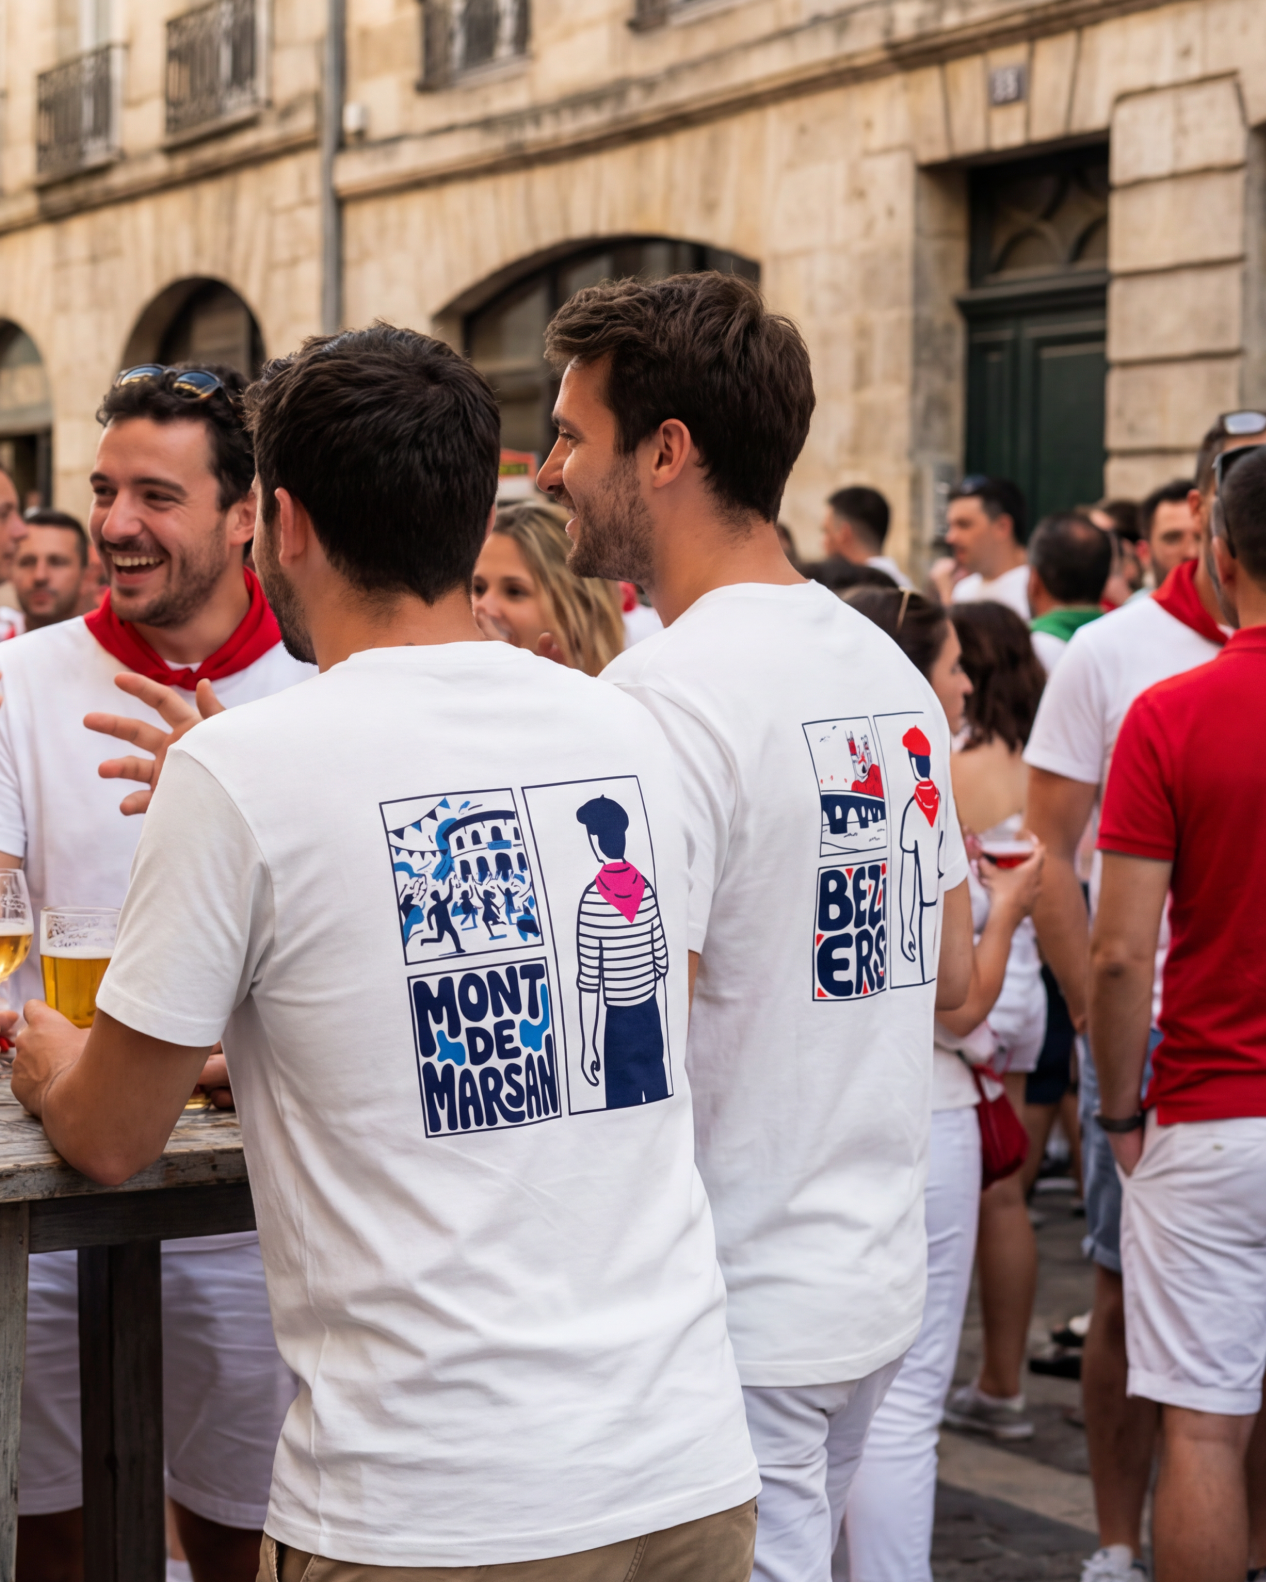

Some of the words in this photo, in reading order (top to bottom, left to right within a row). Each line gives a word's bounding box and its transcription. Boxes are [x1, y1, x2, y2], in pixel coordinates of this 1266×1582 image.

[412, 963, 546, 1058] MONT
[465, 1018, 522, 1066] DE
[422, 1033, 559, 1133] MARSAN
